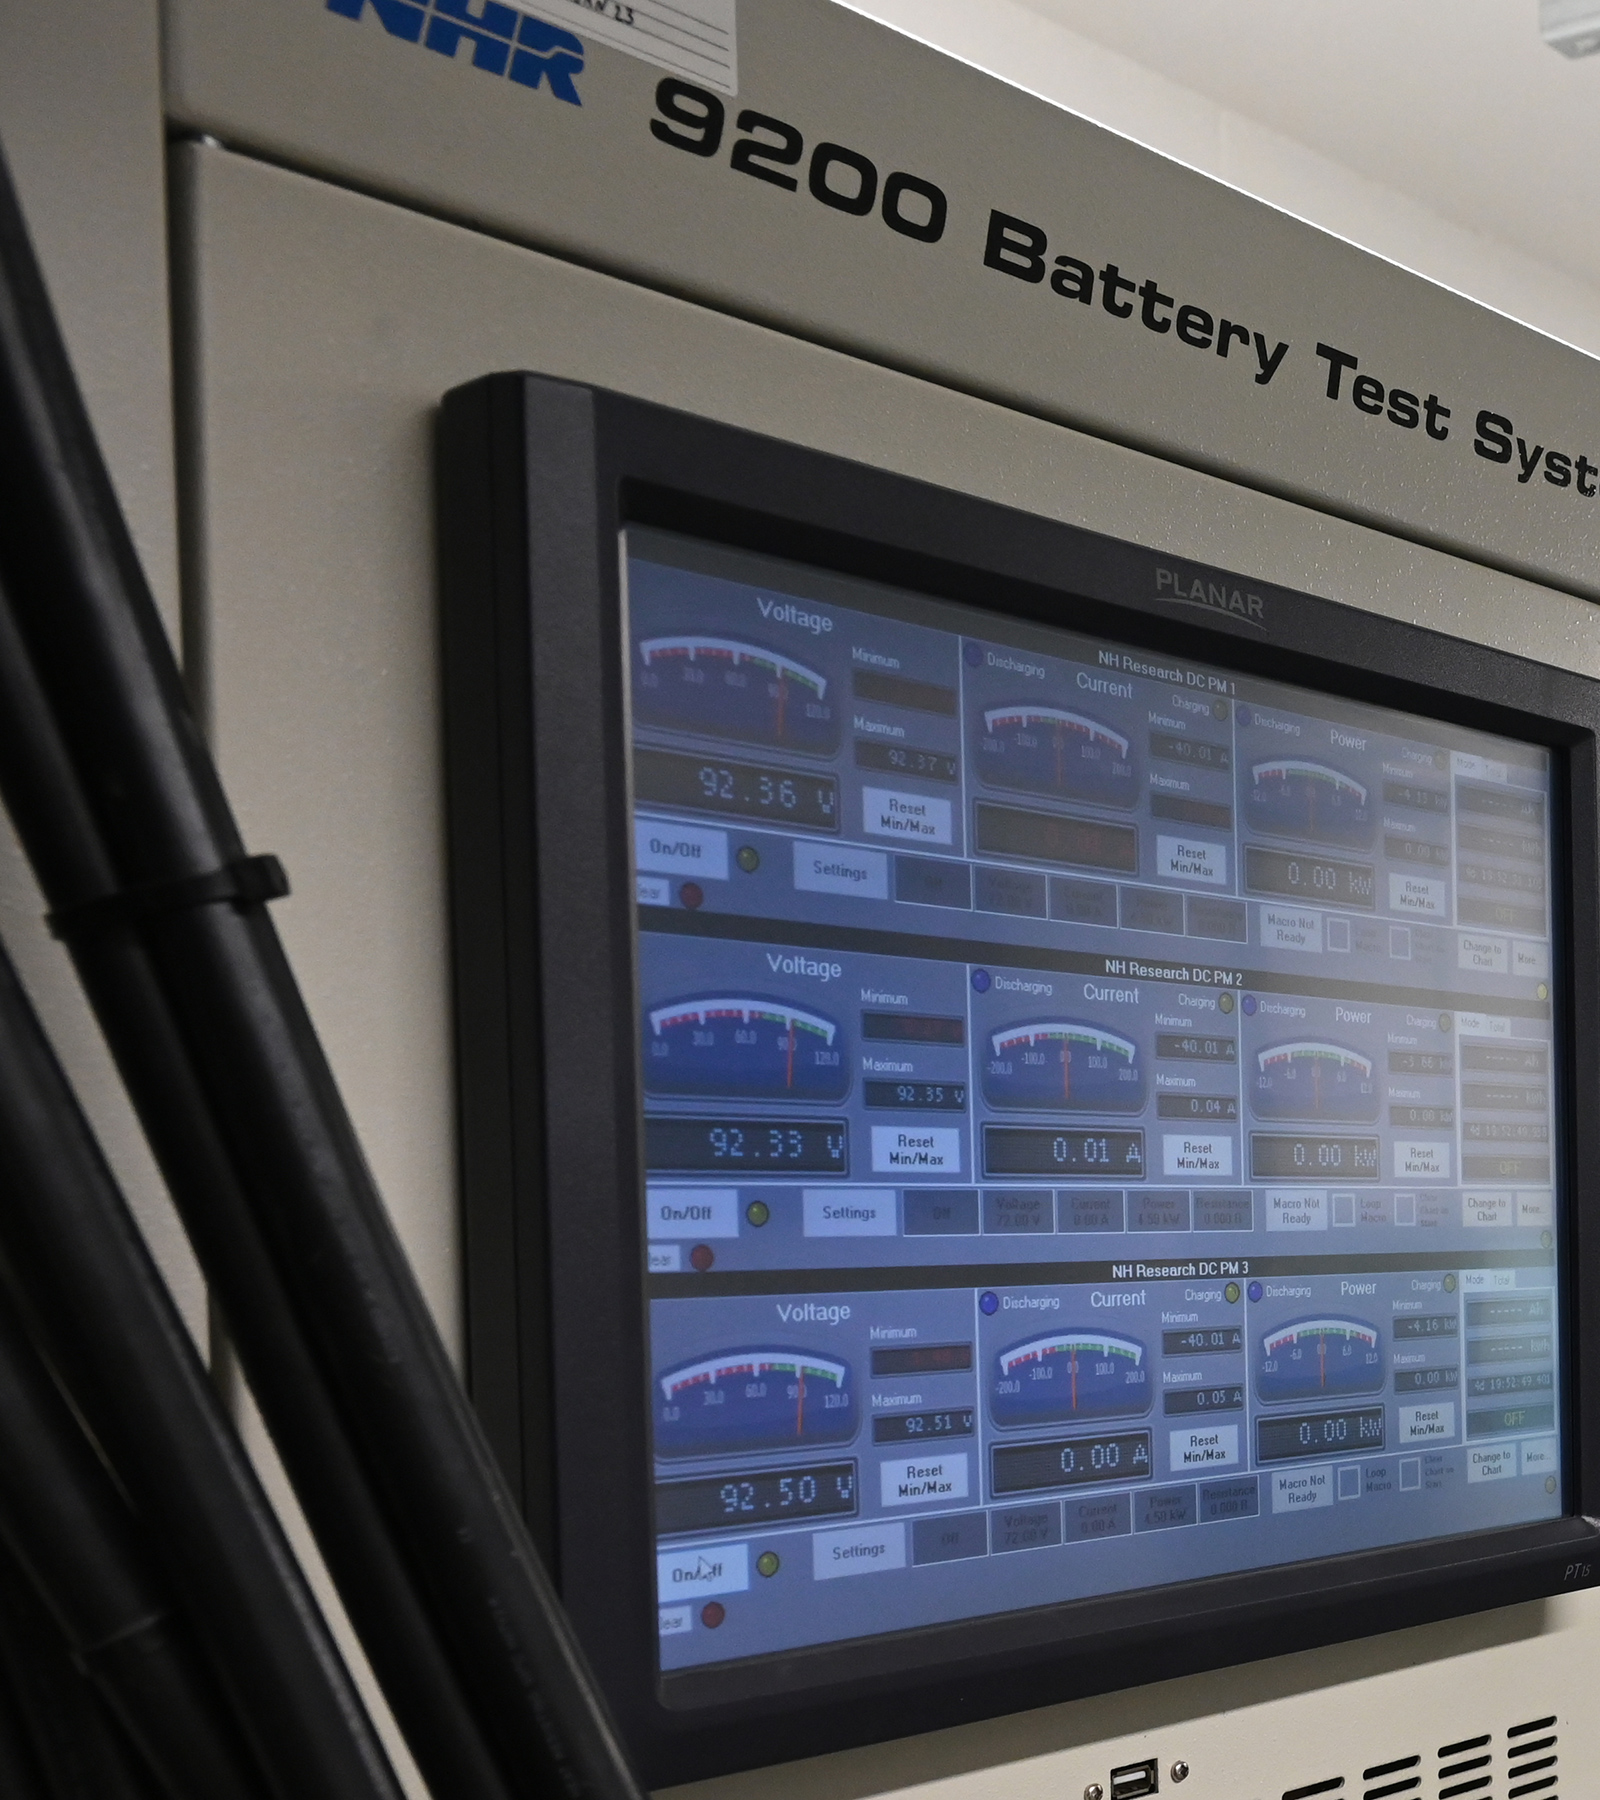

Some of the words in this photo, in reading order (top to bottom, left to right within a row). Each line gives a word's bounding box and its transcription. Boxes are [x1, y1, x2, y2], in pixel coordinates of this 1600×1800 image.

[615, 5, 634, 25] 23
[325, 0, 585, 107] NHR
[650, 76, 947, 244] 9200
[983, 209, 1289, 385] Battery
[1315, 343, 1450, 441] Test
[1155, 567, 1265, 619] PLANAR
[756, 597, 834, 635] Voltage
[852, 646, 901, 669] Minimum
[987, 652, 1045, 680] Discharging
[1099, 650, 1120, 669] NH
[1123, 655, 1183, 683] Research
[1187, 671, 1205, 688] DC
[1208, 676, 1227, 693] PM
[1230, 682, 1236, 695] 1
[1076, 672, 1134, 699] Current
[1172, 694, 1210, 717] Charging
[853, 714, 905, 738] Maximum
[1148, 710, 1187, 731] Minimum
[1254, 713, 1301, 737] Discharging
[1329, 727, 1367, 752] Power
[888, 749, 938, 770] 92.37
[699, 766, 797, 808] 92.36
[1150, 773, 1190, 792] Maximum
[888, 799, 926, 817] Reset
[881, 815, 935, 836] Min/Max
[1177, 844, 1207, 861] Reset
[814, 861, 867, 881] Settings
[1170, 860, 1213, 878] Min/Max
[1288, 861, 1336, 891] 0.00
[1405, 881, 1429, 896] Reset
[1400, 894, 1435, 911] Min/Max
[1268, 913, 1296, 928] Macro
[1298, 917, 1314, 930] Not
[1276, 929, 1306, 947] Ready
[766, 953, 842, 983] Voltage
[1105, 959, 1126, 975] NH
[1130, 962, 1189, 982] Research
[1192, 969, 1211, 983] DC
[1214, 971, 1232, 985] PM
[1235, 973, 1243, 986] 2
[995, 976, 1053, 996] Discharging
[1084, 984, 1140, 1004] Current
[860, 987, 909, 1006] Minimum
[1178, 993, 1216, 1010] Charging
[1260, 1001, 1306, 1019] Discharging
[1335, 1006, 1372, 1025] Power
[1155, 1013, 1192, 1028] Minimum
[1175, 1040, 1218, 1055] -40.01
[1226, 1044, 1235, 1055] A
[862, 1056, 914, 1073] Maximum
[1156, 1073, 1196, 1088] Maximum
[897, 1086, 943, 1101] 92.35
[1191, 1099, 1220, 1113] 0.04
[1227, 1102, 1236, 1114] A
[709, 1127, 801, 1157] 92.33
[898, 1134, 935, 1148] Reset
[1184, 1142, 1212, 1155] Reset
[1053, 1137, 1110, 1163] 0.01
[1126, 1143, 1141, 1163] A
[1293, 1143, 1341, 1167] 0.00
[1354, 1145, 1377, 1168] kW
[1410, 1148, 1434, 1160] Reset
[889, 1151, 943, 1167] Min/Max
[1177, 1157, 1220, 1170] Min/Max
[1405, 1160, 1440, 1174] Min/Max
[1273, 1198, 1301, 1209] Macro
[1304, 1198, 1320, 1209] Not
[1467, 1198, 1495, 1211] Change
[1498, 1199, 1506, 1209] to
[660, 1206, 712, 1221] On/Off
[822, 1206, 877, 1220] Settings
[1282, 1212, 1312, 1226] Ready
[1477, 1211, 1497, 1222] Chart
[1112, 1264, 1133, 1278] NH
[1137, 1262, 1195, 1278] Research
[1199, 1262, 1218, 1276] DC
[1221, 1262, 1239, 1275] PM
[1242, 1261, 1249, 1274] 3
[1411, 1279, 1442, 1292] Charging
[1466, 1274, 1484, 1285] Mode
[1185, 1289, 1222, 1303] Charging
[1266, 1284, 1311, 1300] Discharging
[1341, 1281, 1377, 1297] Power
[1003, 1295, 1060, 1311] Discharging
[1091, 1289, 1147, 1308] Current
[1392, 1299, 1422, 1311] Minimum
[777, 1303, 850, 1325] Voltage
[1162, 1311, 1198, 1324] Minimum
[869, 1325, 917, 1340] Minimum
[1407, 1318, 1438, 1332] -4.16
[1181, 1333, 1225, 1347] -40.01
[1232, 1333, 1241, 1345] A
[1125, 1371, 1145, 1384] 200.0
[1163, 1371, 1203, 1384] Maximum
[1415, 1371, 1439, 1384] 0.00
[995, 1381, 1021, 1394] -200.0
[872, 1393, 922, 1408] Maximum
[1196, 1391, 1226, 1405] 0.05
[1233, 1391, 1242, 1402] A
[1415, 1410, 1439, 1422] Reset
[1504, 1411, 1526, 1426] OFF
[905, 1417, 952, 1434] 92.51
[1299, 1419, 1347, 1445] 0.00
[1359, 1416, 1382, 1437] kW
[1410, 1424, 1444, 1437] Min/Max
[1190, 1434, 1219, 1447] Reset
[1061, 1443, 1121, 1473] 0.00
[1133, 1444, 1148, 1466] A
[1183, 1448, 1226, 1463] Min/Max
[1472, 1452, 1501, 1464] Change
[1503, 1450, 1511, 1460] to
[907, 1465, 943, 1480] Reset
[1365, 1467, 1386, 1480] Loop
[1482, 1463, 1502, 1475] Chart
[898, 1481, 952, 1498] Min/Max
[1280, 1477, 1307, 1490] Macro
[1310, 1475, 1325, 1487] Not
[1366, 1480, 1391, 1492] Macro
[720, 1476, 816, 1513] 92.50
[1288, 1491, 1317, 1505] Ready
[832, 1543, 886, 1561] Settings
[1563, 1562, 1592, 1581] PT15
